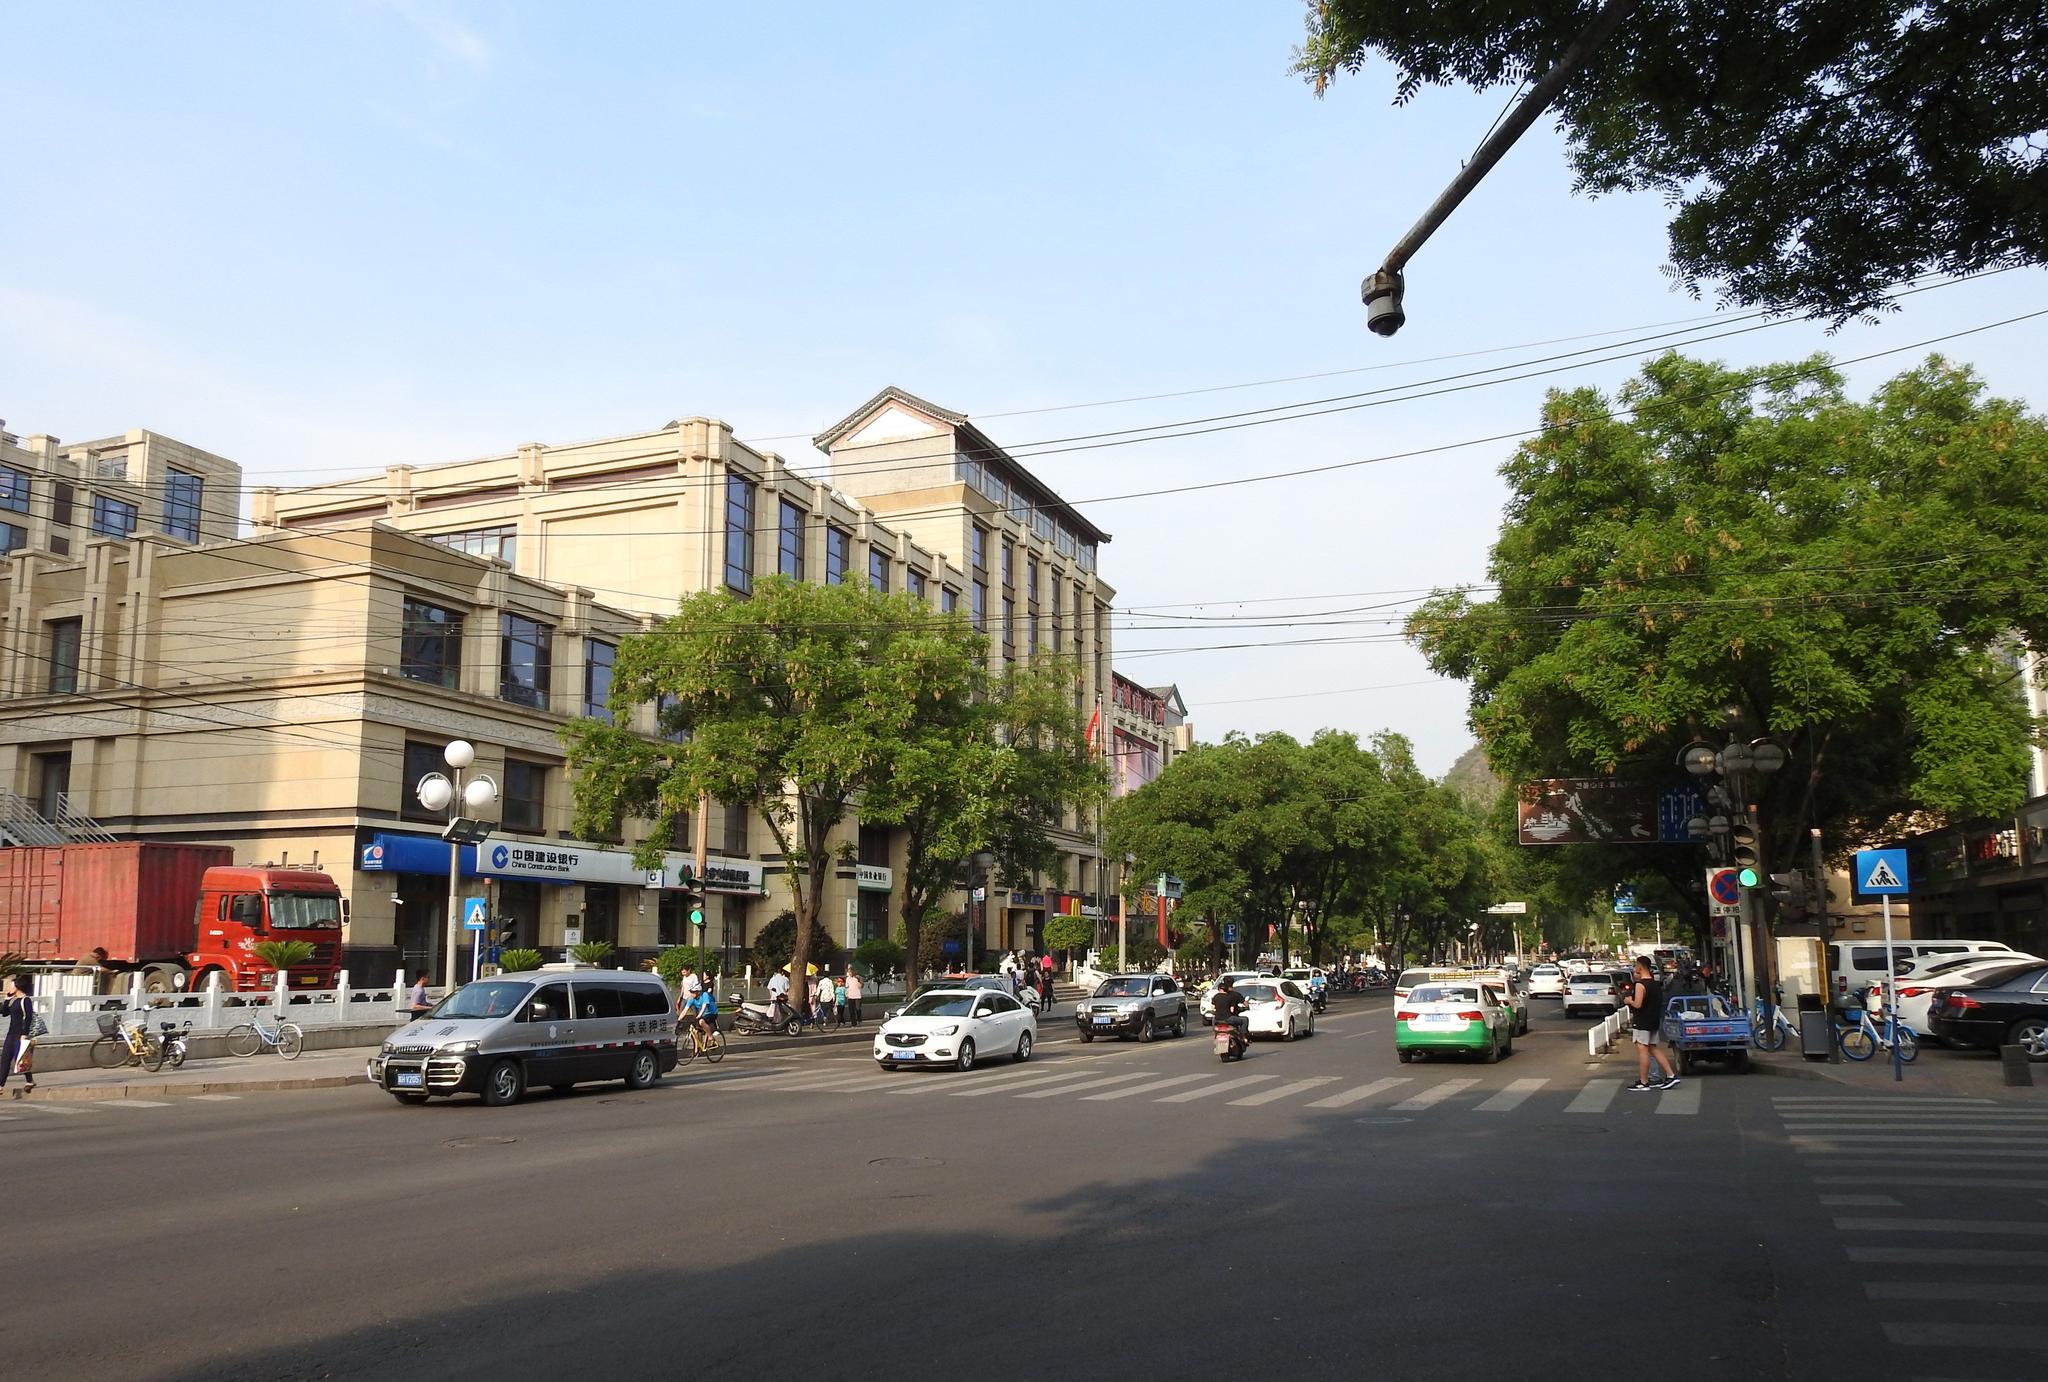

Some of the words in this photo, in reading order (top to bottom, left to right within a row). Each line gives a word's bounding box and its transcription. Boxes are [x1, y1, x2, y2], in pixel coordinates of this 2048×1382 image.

[512, 849, 579, 866] 中国建设银行
[512, 861, 527, 869] China
[527, 863, 557, 871] Construction
[557, 865, 570, 873] Bank
[1228, 924, 1236, 935] P
[627, 1018, 668, 1035] 武装押运
